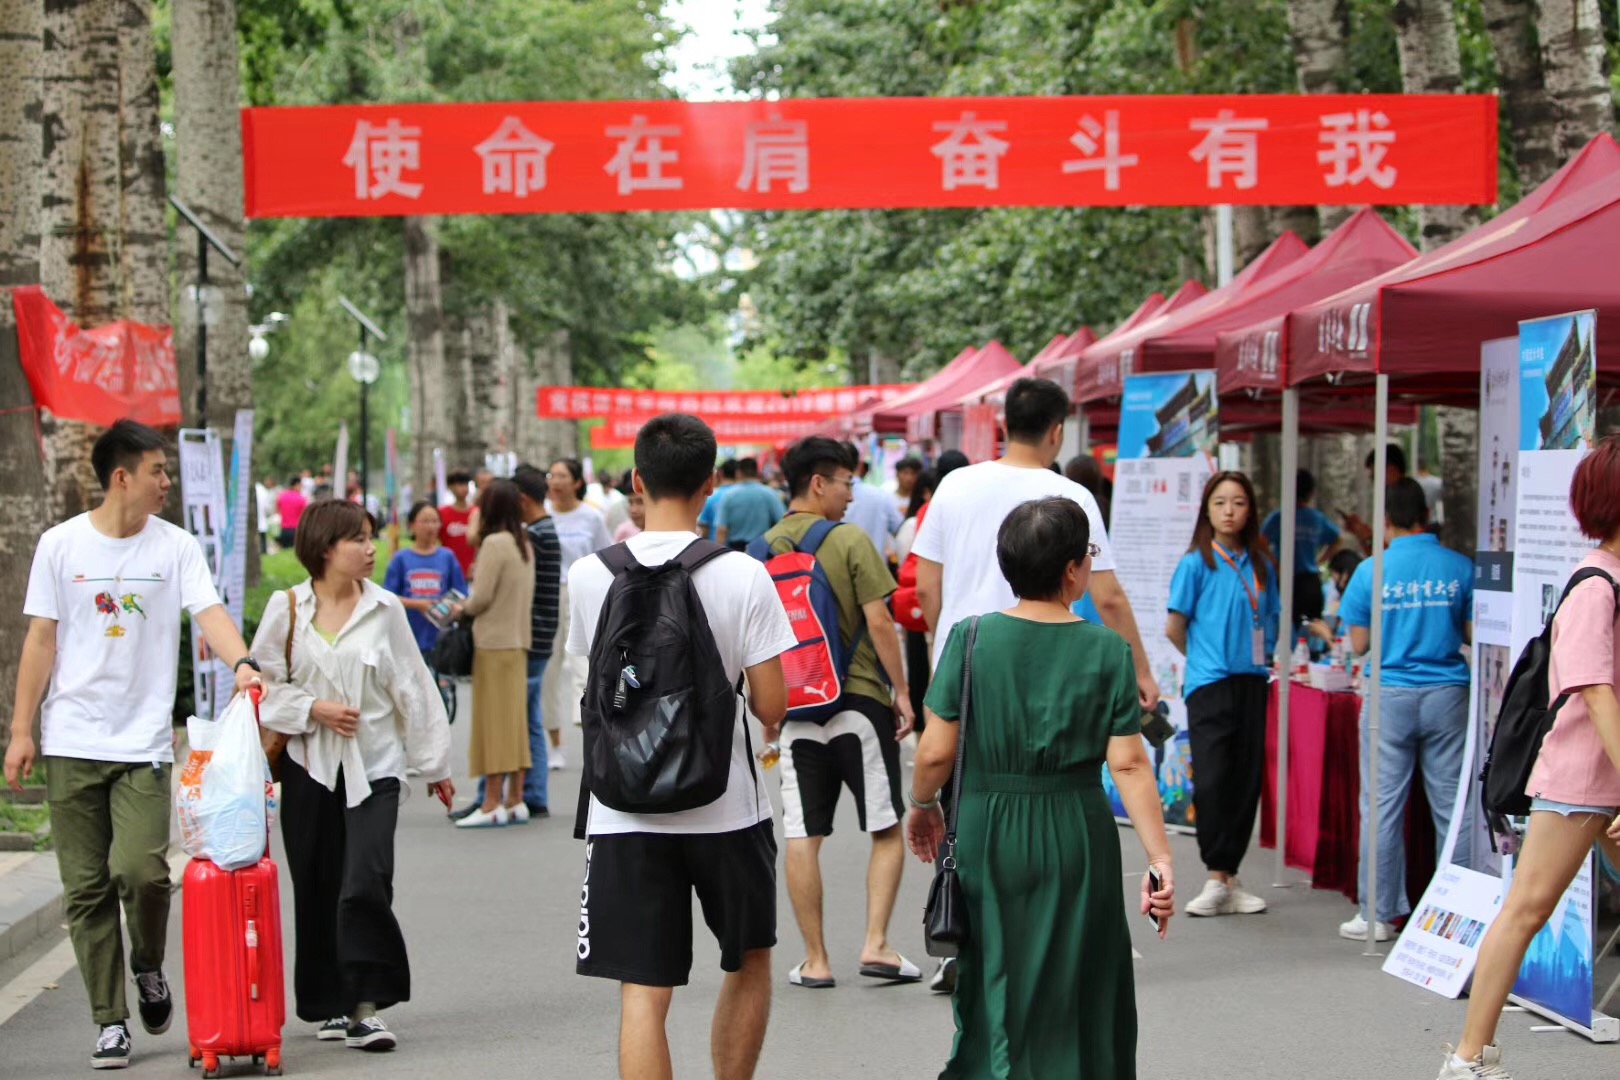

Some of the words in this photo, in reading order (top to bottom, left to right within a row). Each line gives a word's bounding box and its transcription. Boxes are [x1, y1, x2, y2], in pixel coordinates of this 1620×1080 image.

[342, 114, 810, 199] 使命在肩
[930, 109, 1397, 191] 奋斗有我
